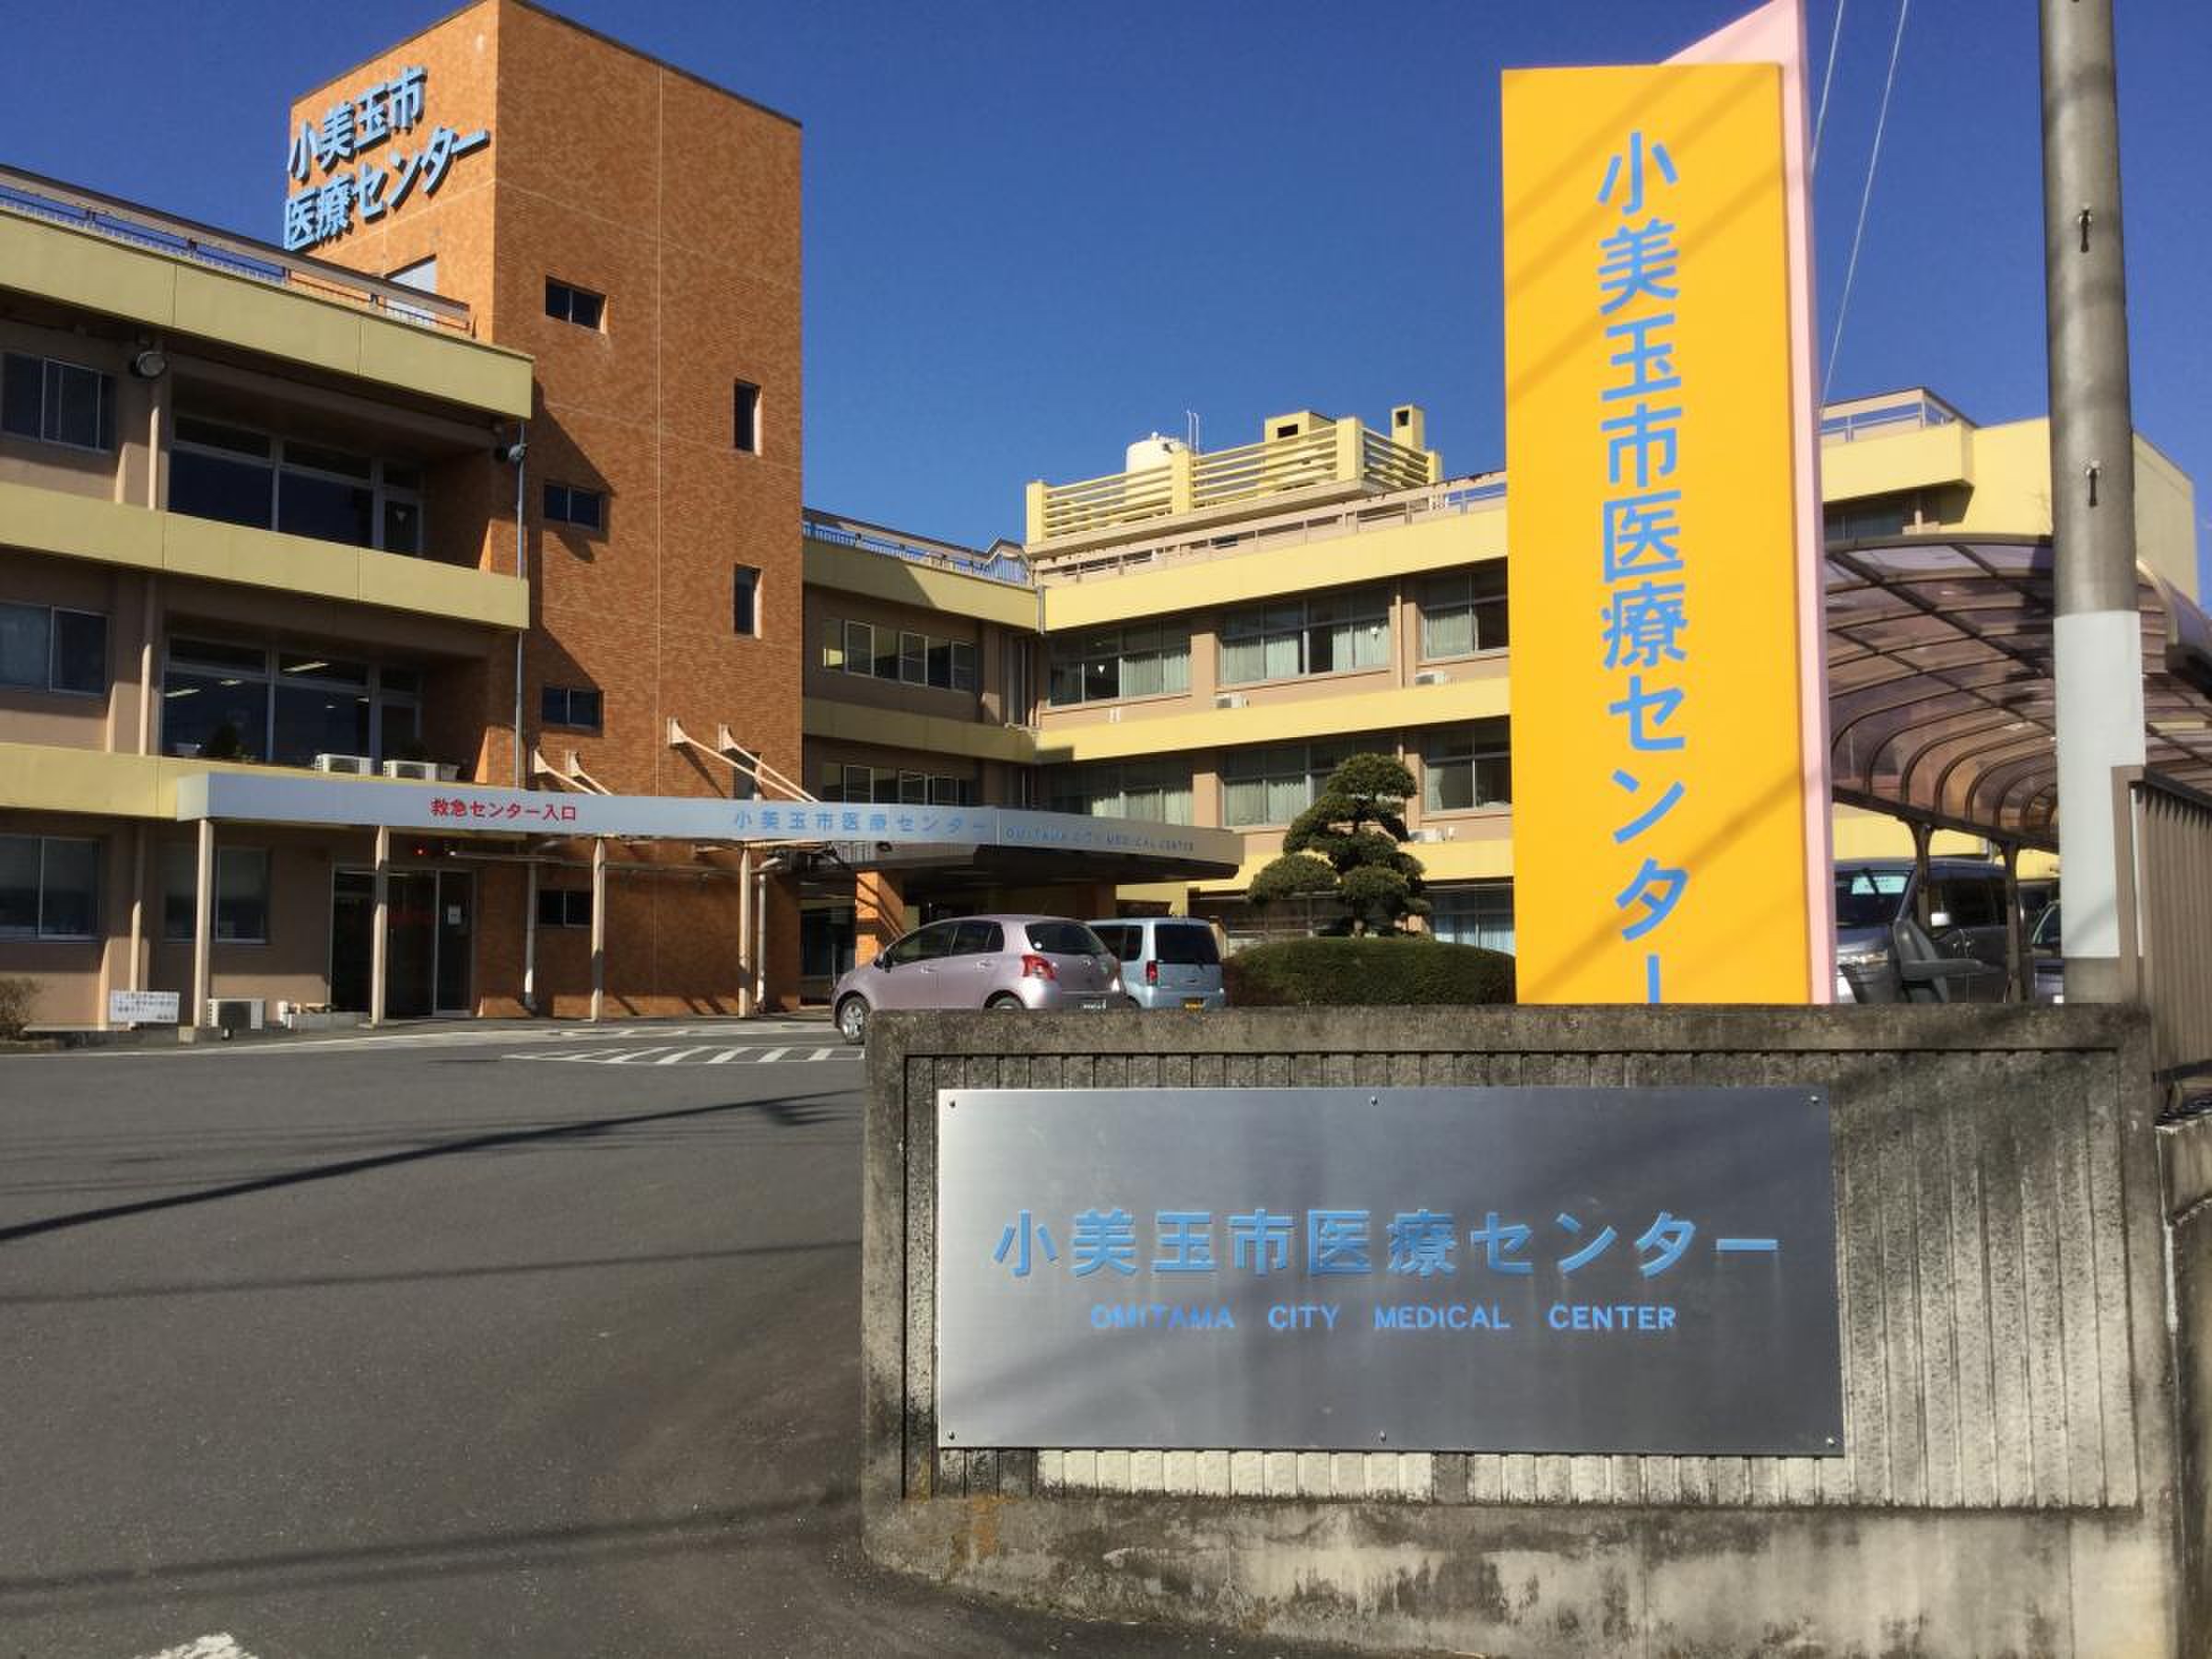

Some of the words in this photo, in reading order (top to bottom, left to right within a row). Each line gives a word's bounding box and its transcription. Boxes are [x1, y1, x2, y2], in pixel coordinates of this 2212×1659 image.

[288, 65, 428, 181] 小美玉市
[284, 125, 490, 251] 医療センター
[1597, 131, 1688, 1003] 小美玉市医療センター
[430, 797, 576, 821] 救急センター入口
[994, 1208, 1779, 1278] 小美玉市医療センター
[1091, 1304, 1236, 1328] OMITAMA
[1268, 1304, 1340, 1328] CITY
[1374, 1305, 1511, 1328] MEDICAL
[1548, 1304, 1677, 1329] CENTER
